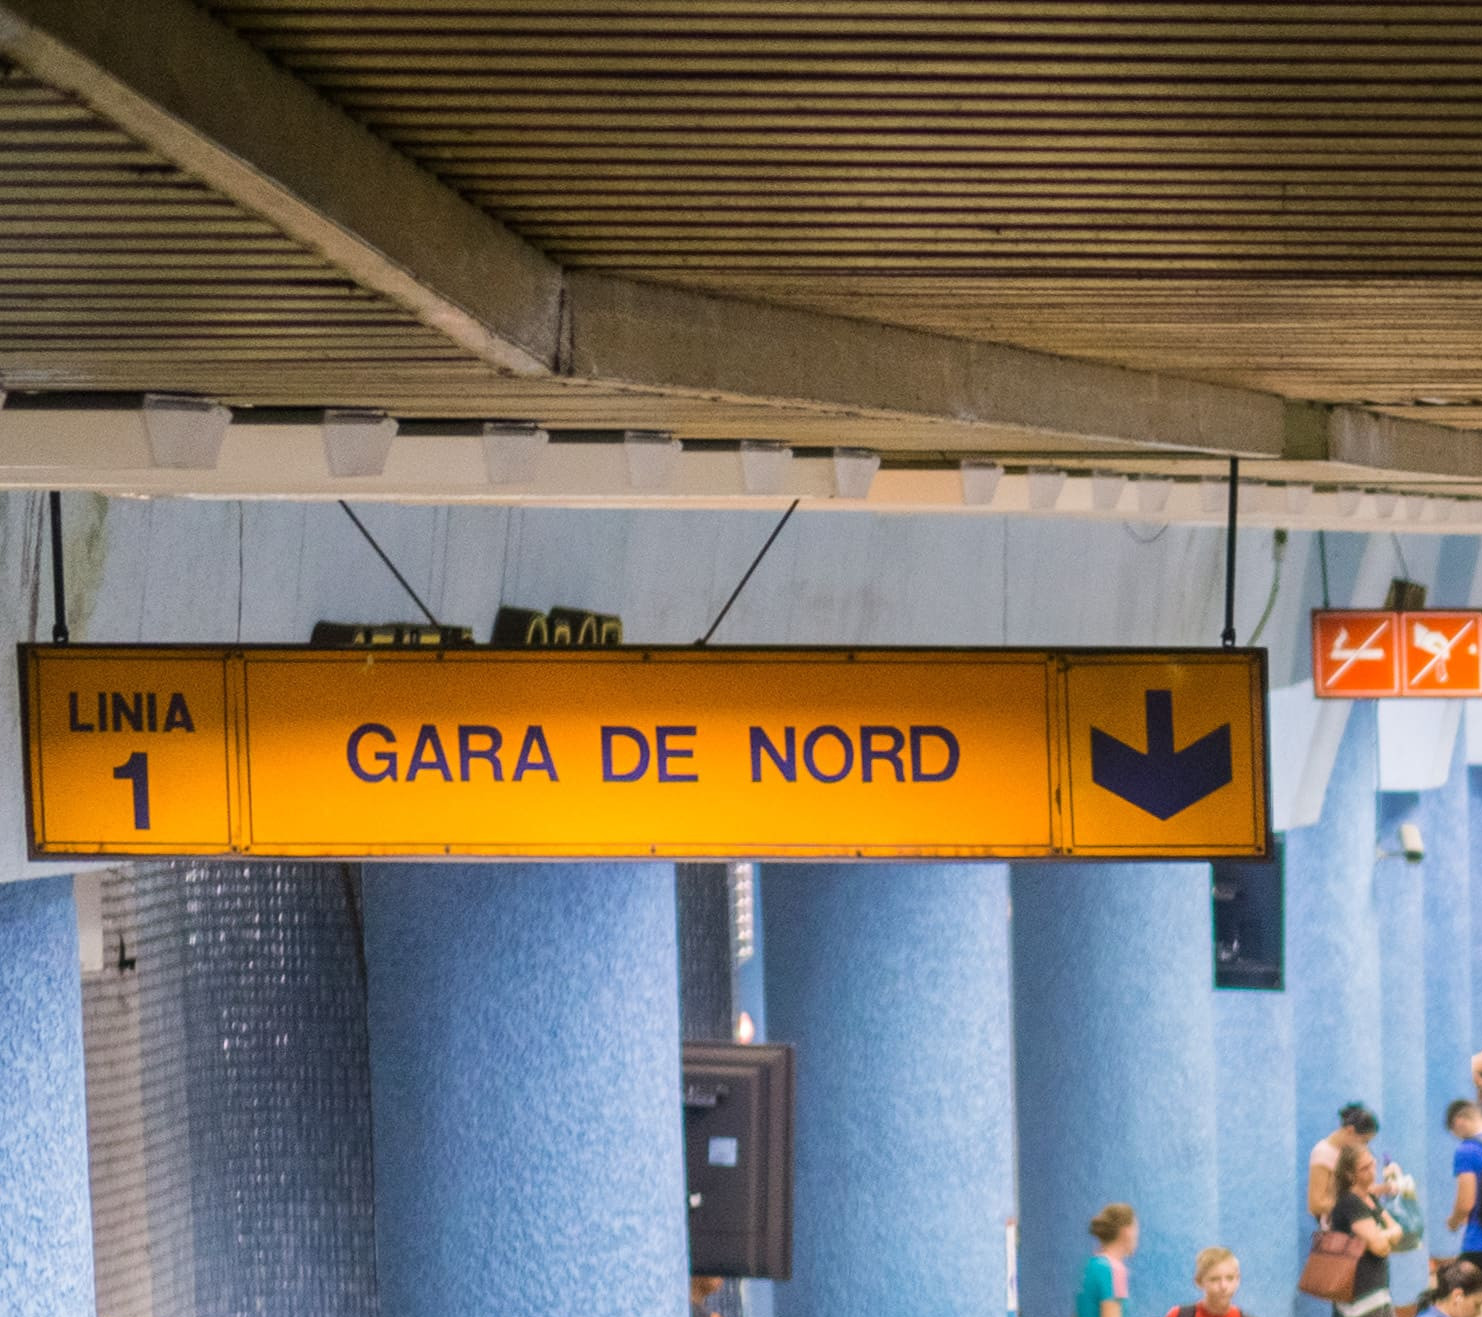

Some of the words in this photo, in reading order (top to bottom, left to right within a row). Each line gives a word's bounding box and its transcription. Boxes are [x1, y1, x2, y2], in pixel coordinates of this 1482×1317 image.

[69, 691, 195, 733] LINIA
[346, 723, 560, 783] GARA
[600, 725, 699, 783] DE
[750, 724, 961, 784] NORD
[113, 752, 150, 830] 1
